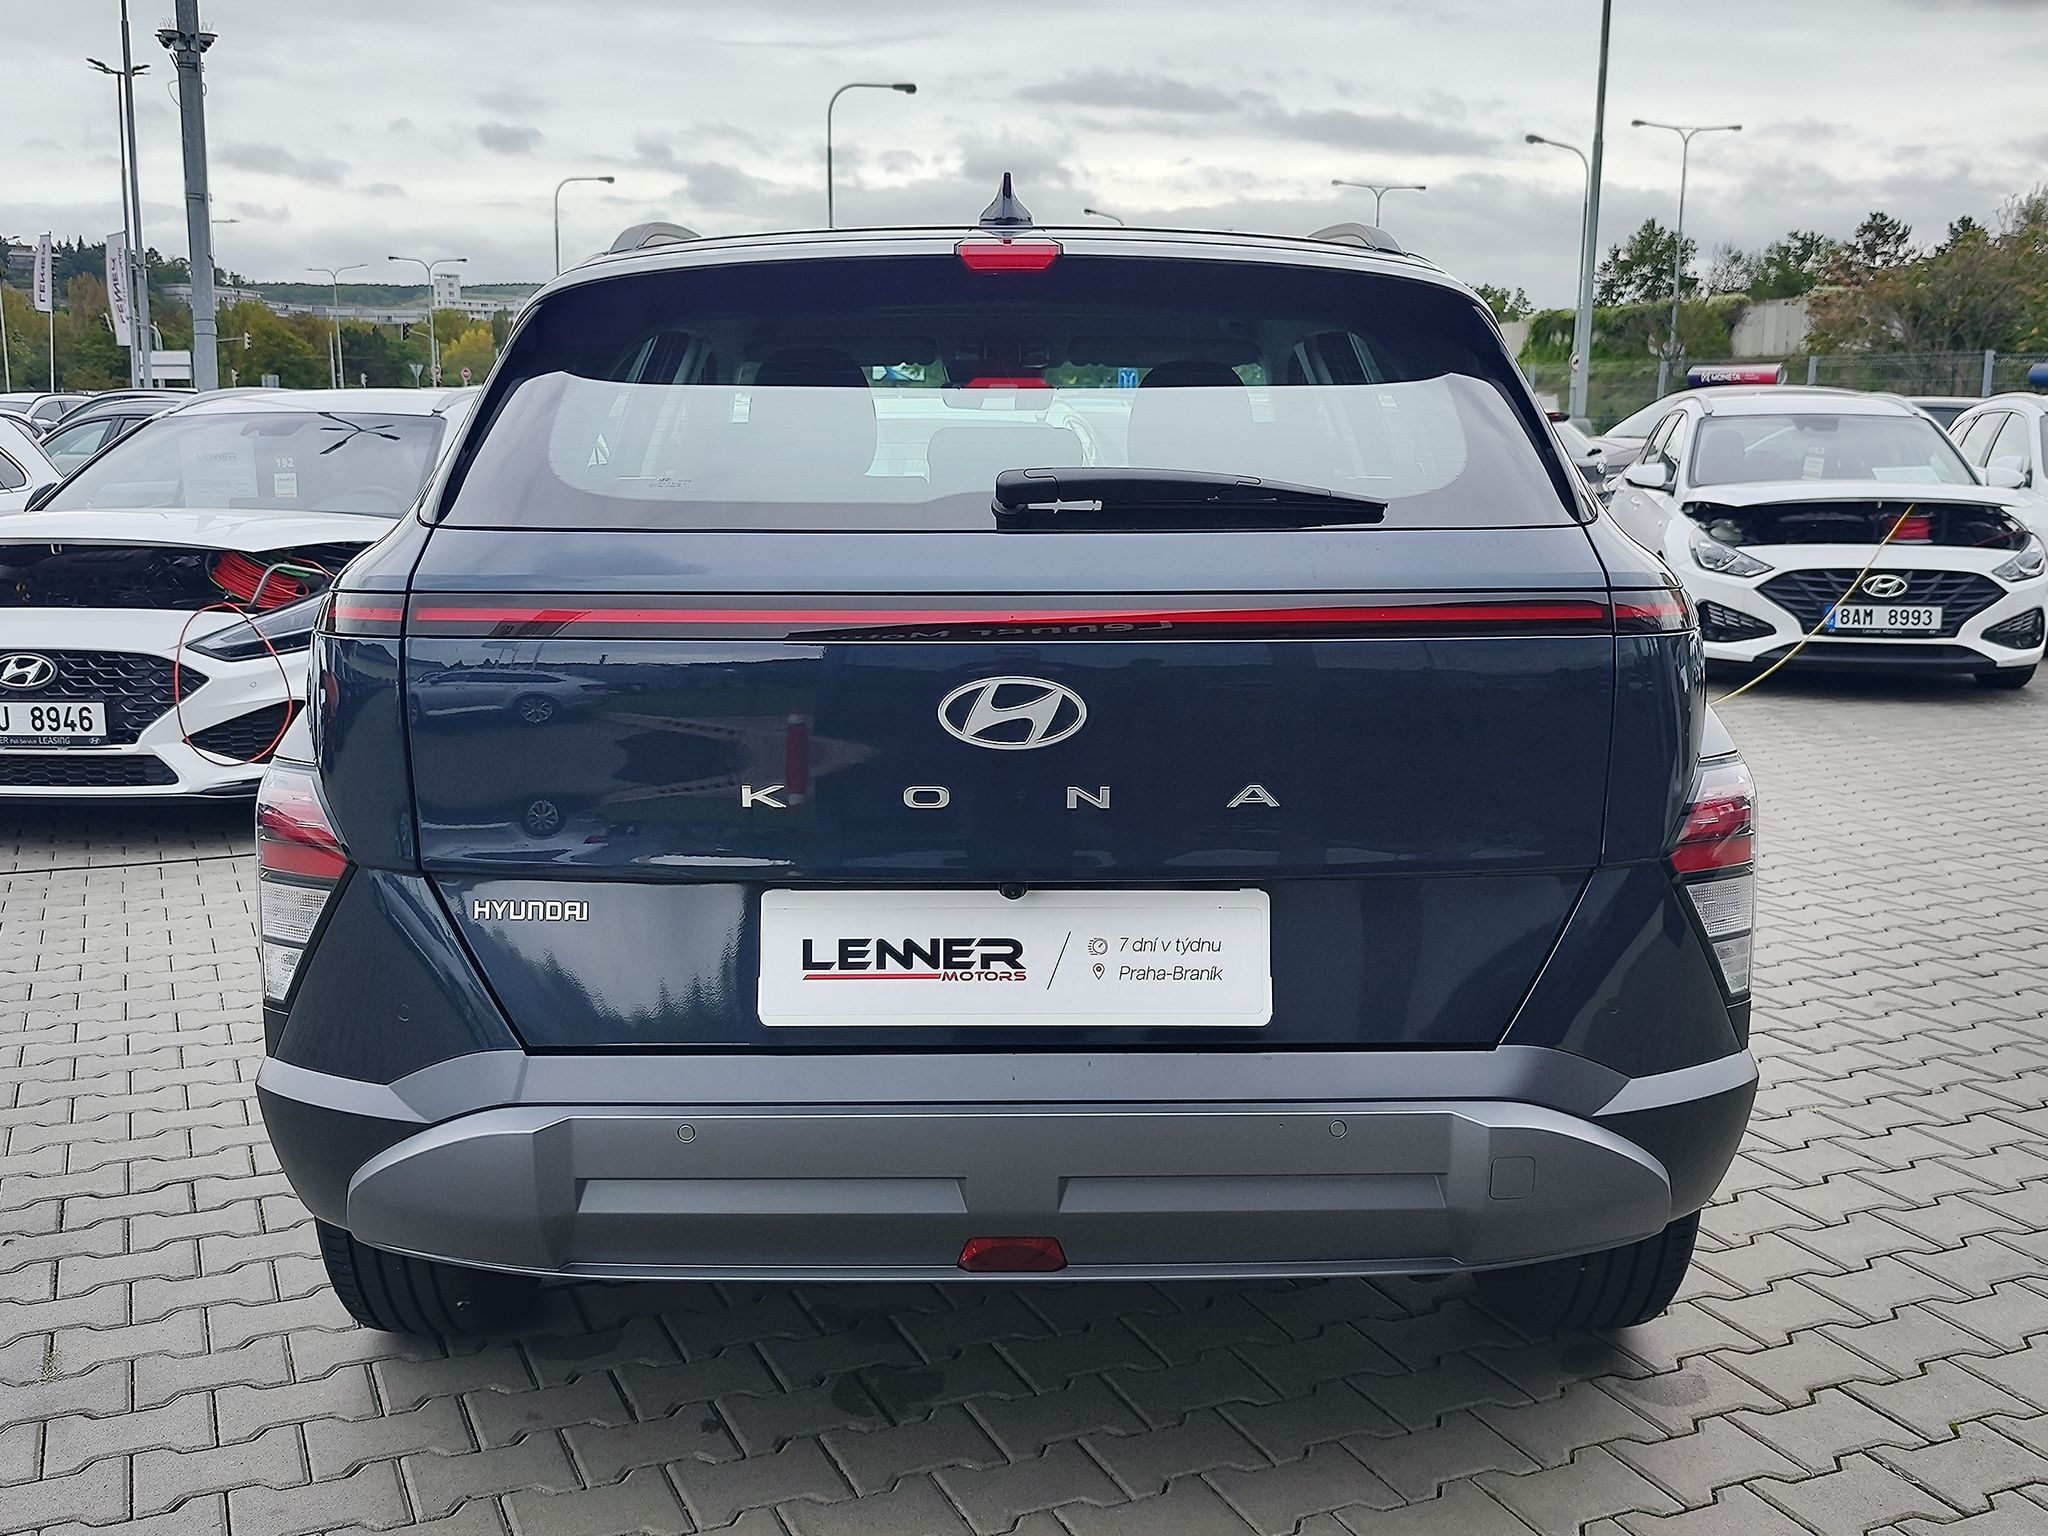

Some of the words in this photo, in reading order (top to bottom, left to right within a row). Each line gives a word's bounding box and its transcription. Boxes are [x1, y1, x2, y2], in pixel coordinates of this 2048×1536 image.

[276, 458, 295, 468] 192
[1840, 608, 1873, 626] 8AM
[1888, 608, 1933, 626] 8993
[30, 706, 93, 732] 8946
[38, 736, 71, 745] LEASING
[740, 784, 1281, 809] KONA
[473, 899, 589, 921] HYUNDAI
[802, 938, 1027, 971] LENNER
[1119, 937, 1129, 952] 7
[1132, 936, 1159, 953] dní
[1161, 940, 1172, 952] v
[1175, 936, 1222, 956] týdnu
[941, 971, 1027, 982] MOTORS
[1119, 965, 1224, 981] Praha-Braník
